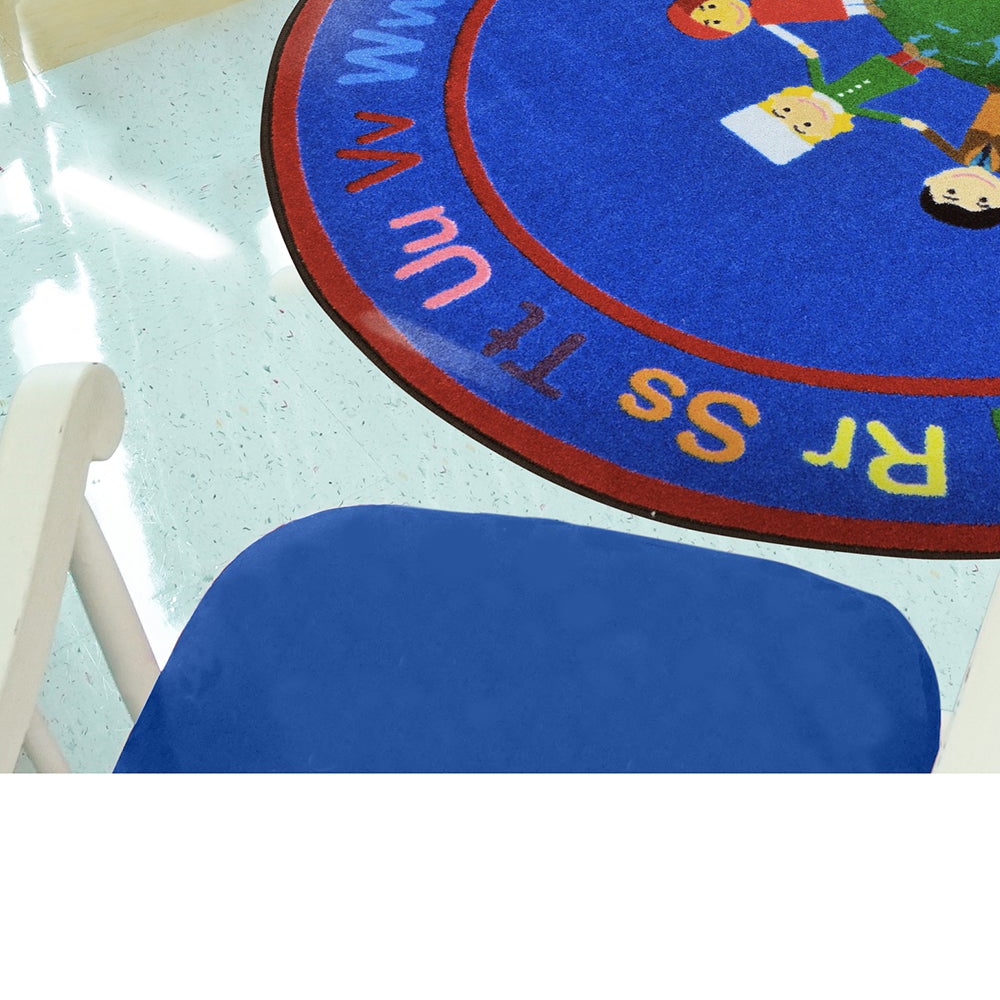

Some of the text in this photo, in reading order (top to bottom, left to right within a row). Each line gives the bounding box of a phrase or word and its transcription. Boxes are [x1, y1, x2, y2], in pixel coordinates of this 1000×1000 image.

[335, 110, 423, 194] Vv
[389, 205, 492, 311] Uu
[480, 300, 588, 401] Tt
[617, 366, 761, 464] Ss
[802, 416, 948, 498] Rr
